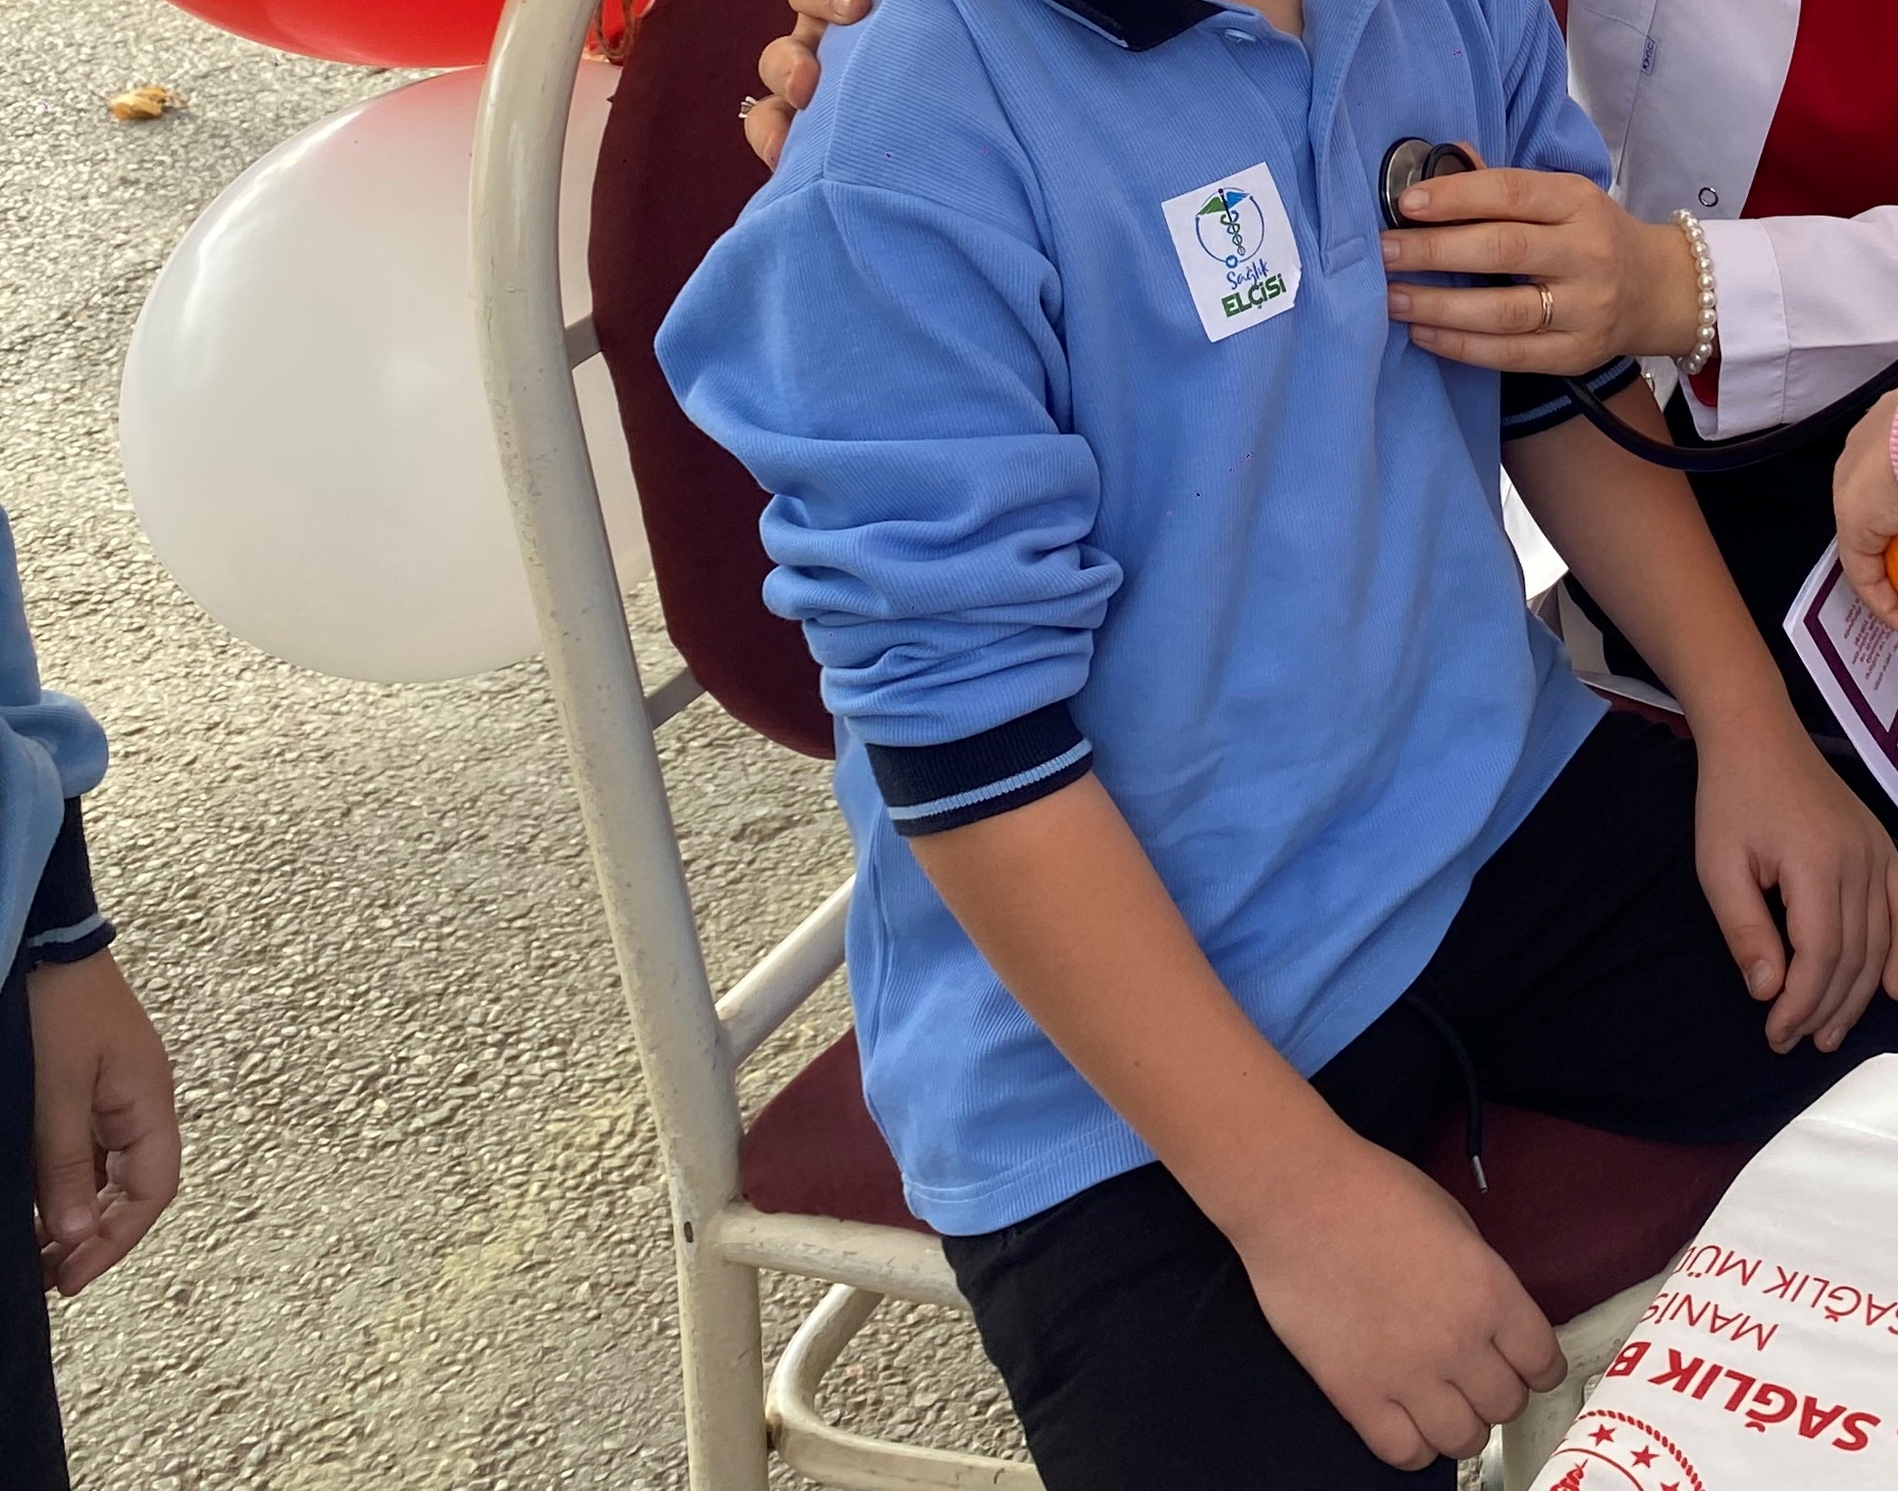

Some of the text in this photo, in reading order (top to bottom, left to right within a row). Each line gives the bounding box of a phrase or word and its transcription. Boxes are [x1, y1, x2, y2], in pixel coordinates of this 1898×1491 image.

[1220, 272, 1289, 319] ELÇİSİ
[1225, 258, 1270, 291] Sağlık
[1647, 1347, 1882, 1453] SAĞLIK
